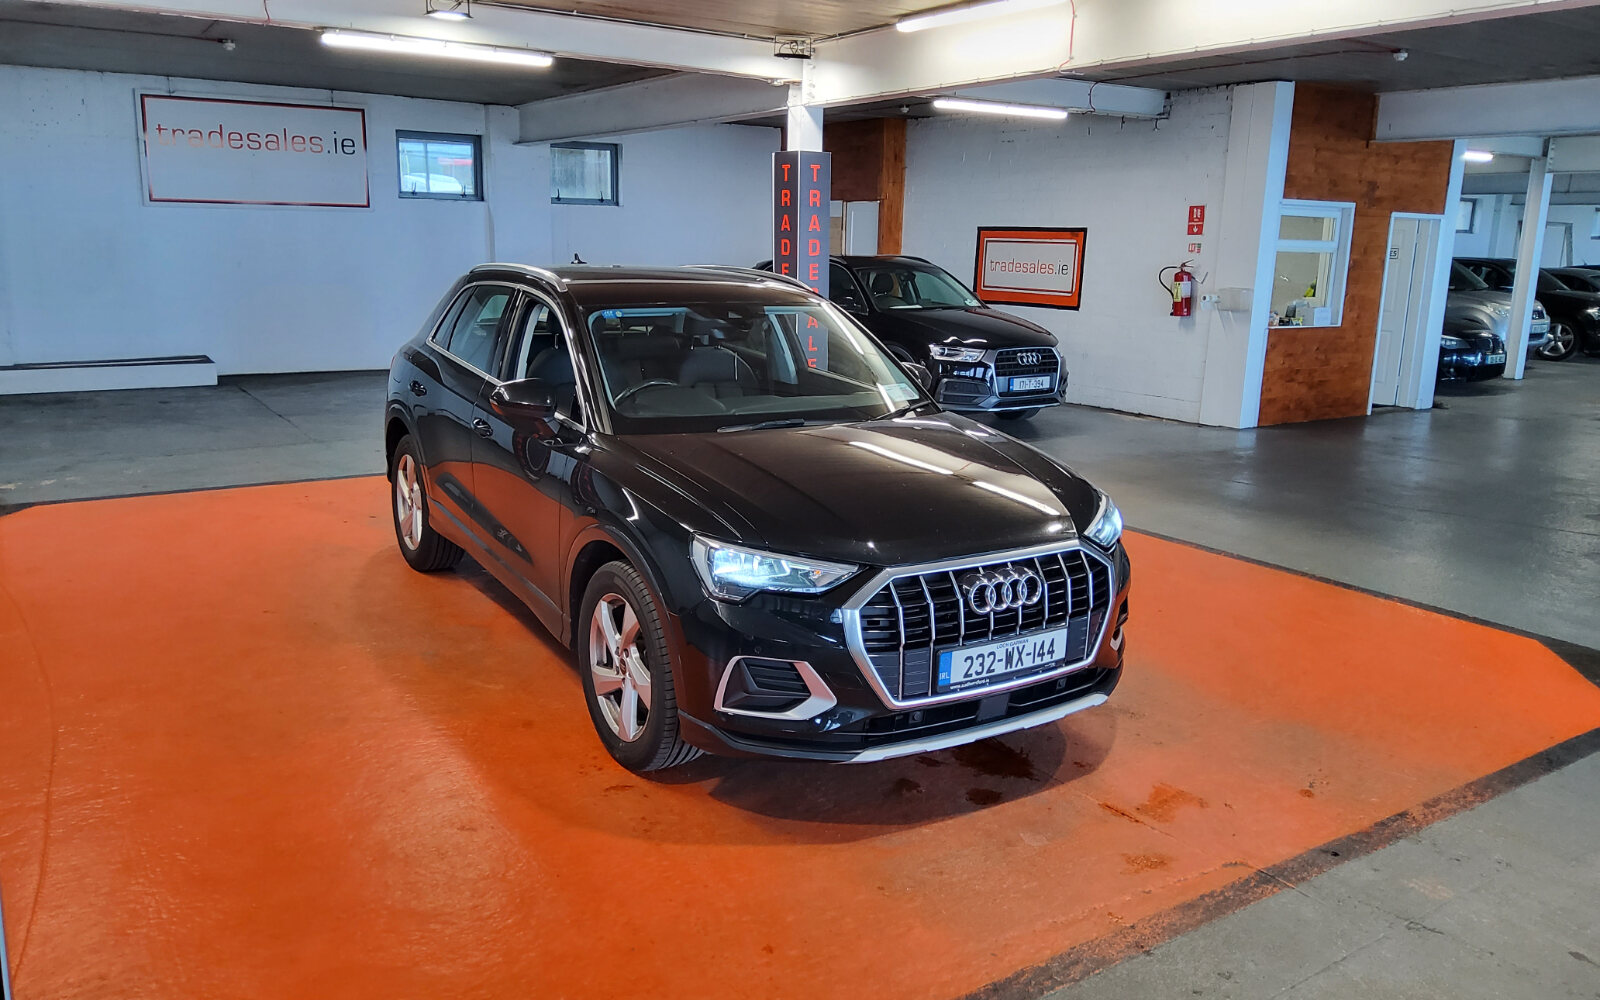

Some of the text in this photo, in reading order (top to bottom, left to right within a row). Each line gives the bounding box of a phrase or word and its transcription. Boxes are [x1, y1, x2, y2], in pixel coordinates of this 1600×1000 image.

[155, 123, 356, 155] tradesales.ie
[780, 164, 791, 276] TRADE
[989, 258, 1069, 276] tradesales.ie
[963, 638, 1056, 679] 232-WX-144
[939, 671, 951, 680] IRL
